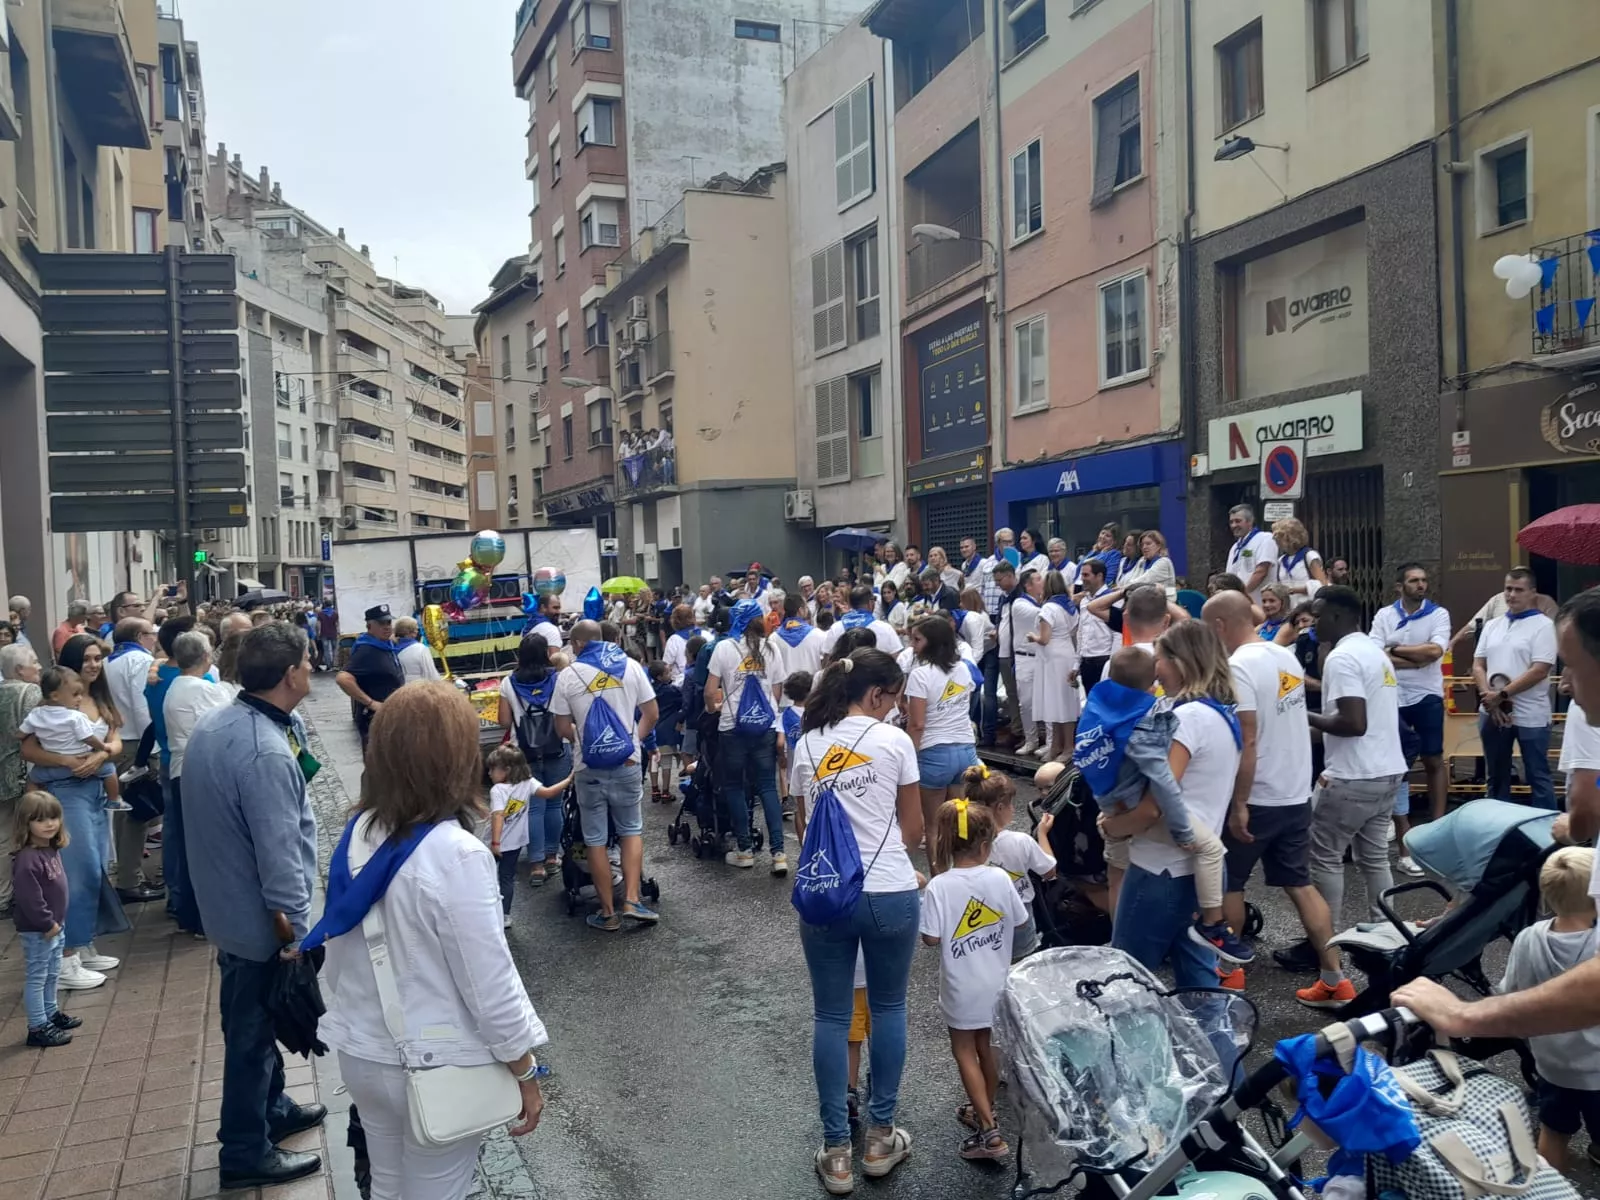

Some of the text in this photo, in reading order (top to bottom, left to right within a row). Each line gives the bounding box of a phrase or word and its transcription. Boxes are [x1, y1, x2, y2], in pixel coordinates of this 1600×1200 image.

[1056, 470, 1080, 493] AXA
[827, 753, 843, 770] e
[968, 909, 982, 928] e
[951, 942, 966, 959] El
